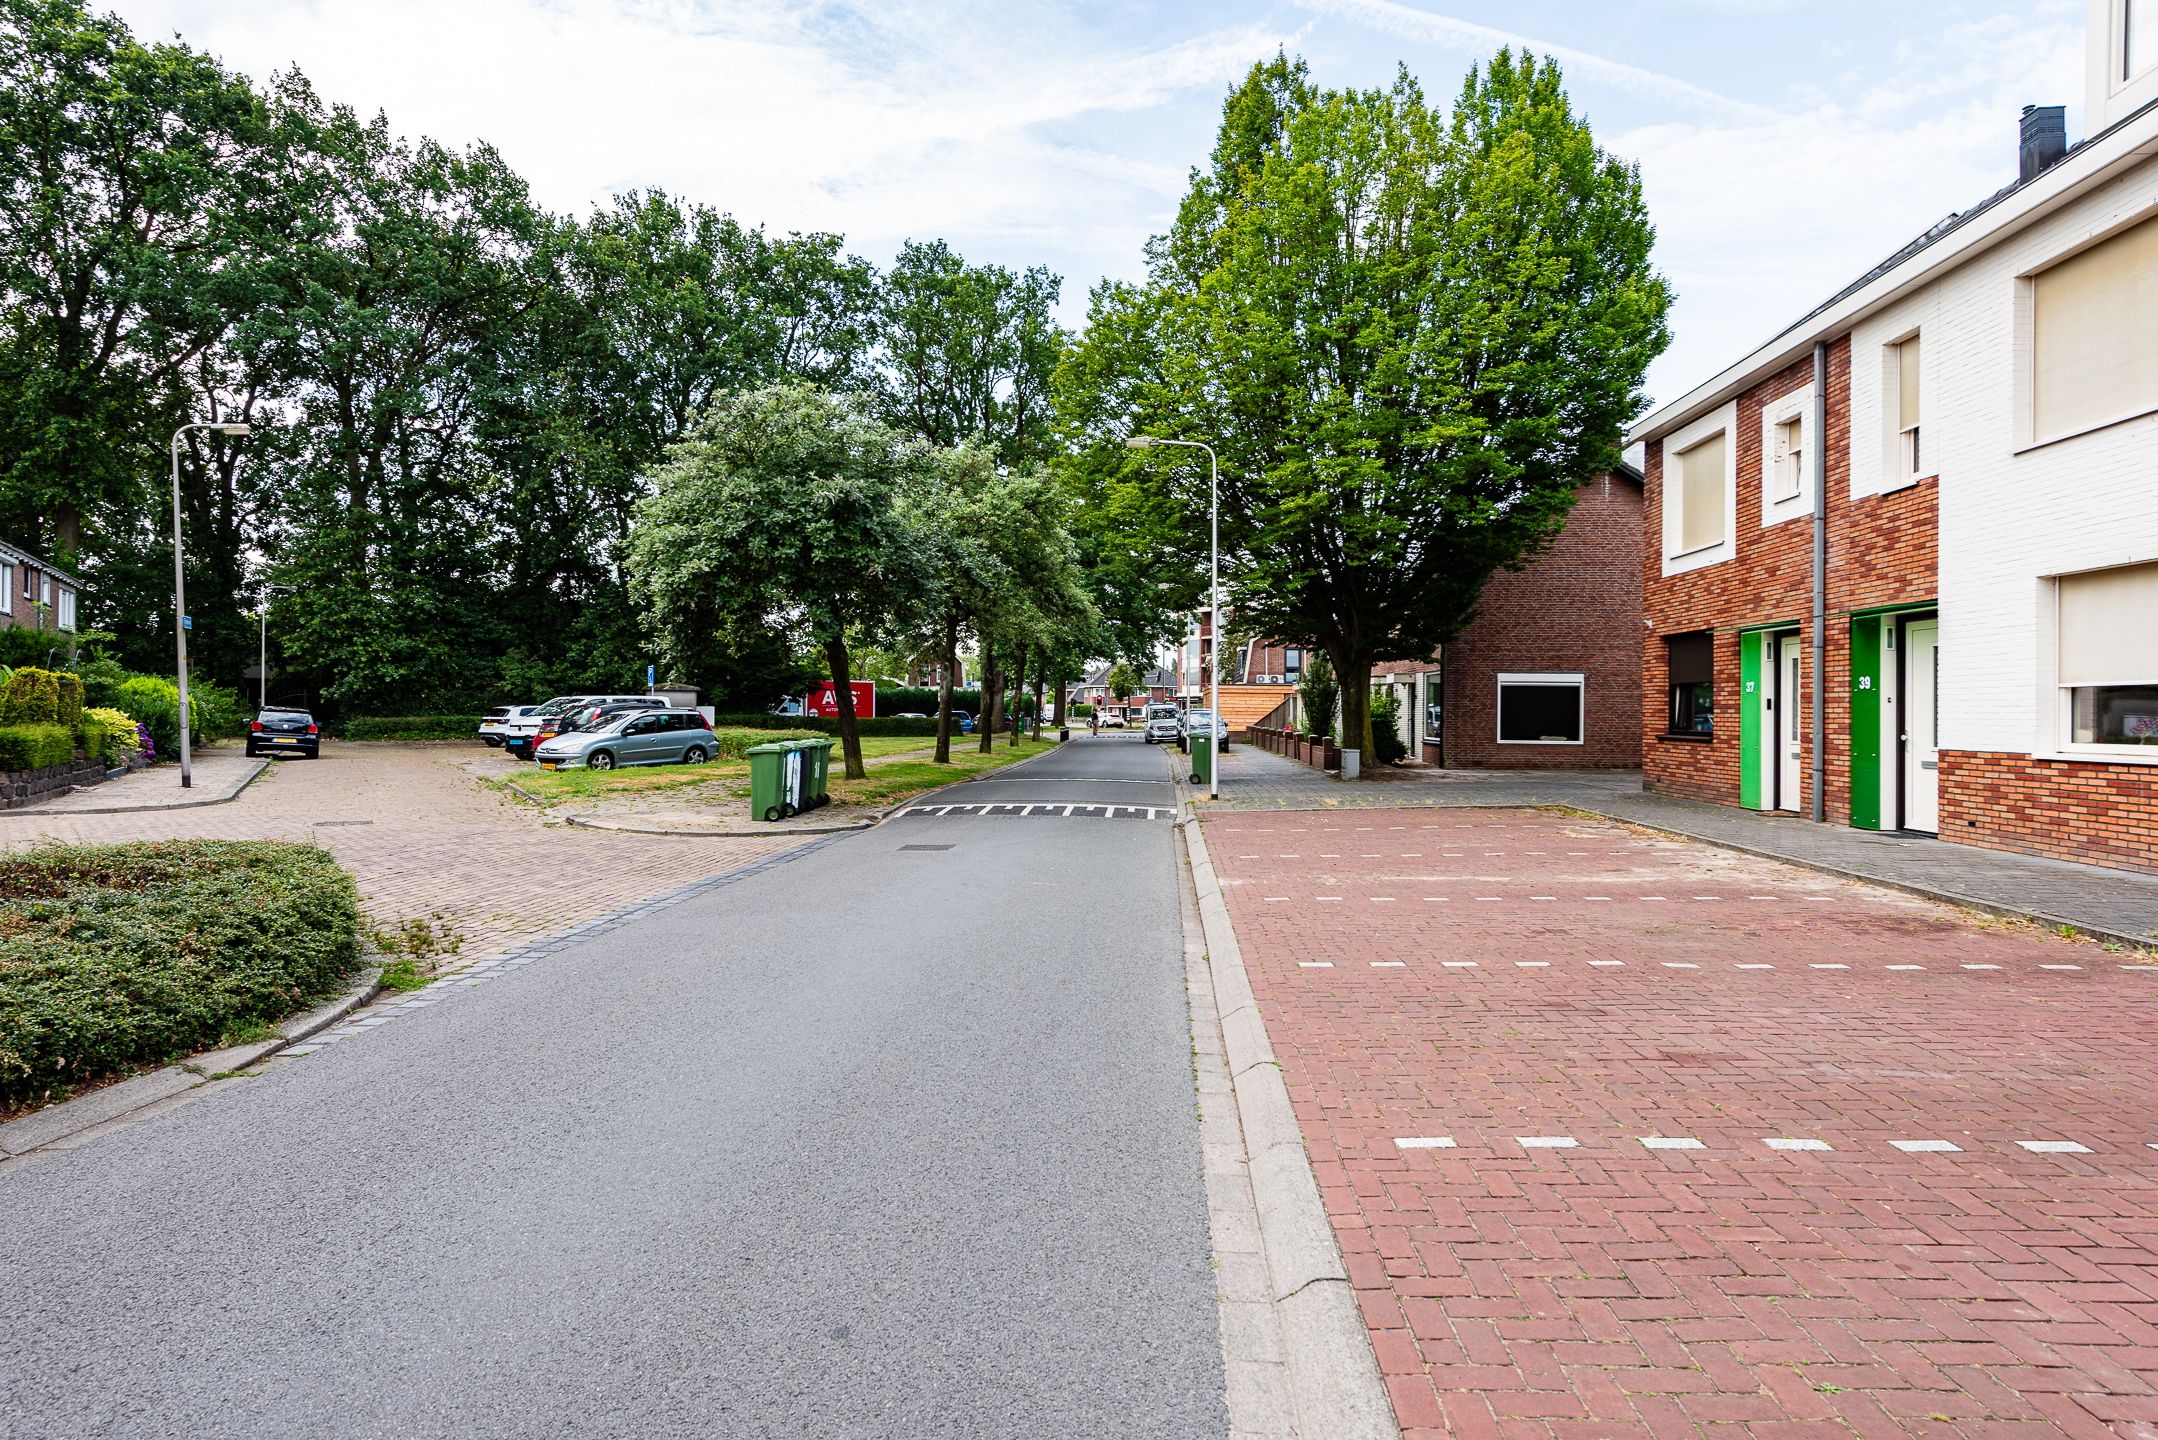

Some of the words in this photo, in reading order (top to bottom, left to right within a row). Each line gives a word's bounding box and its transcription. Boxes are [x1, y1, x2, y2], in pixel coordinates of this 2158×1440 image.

[1745, 681, 1755, 693] 37
[1858, 676, 1870, 689] 39
[821, 690, 858, 705] AS
